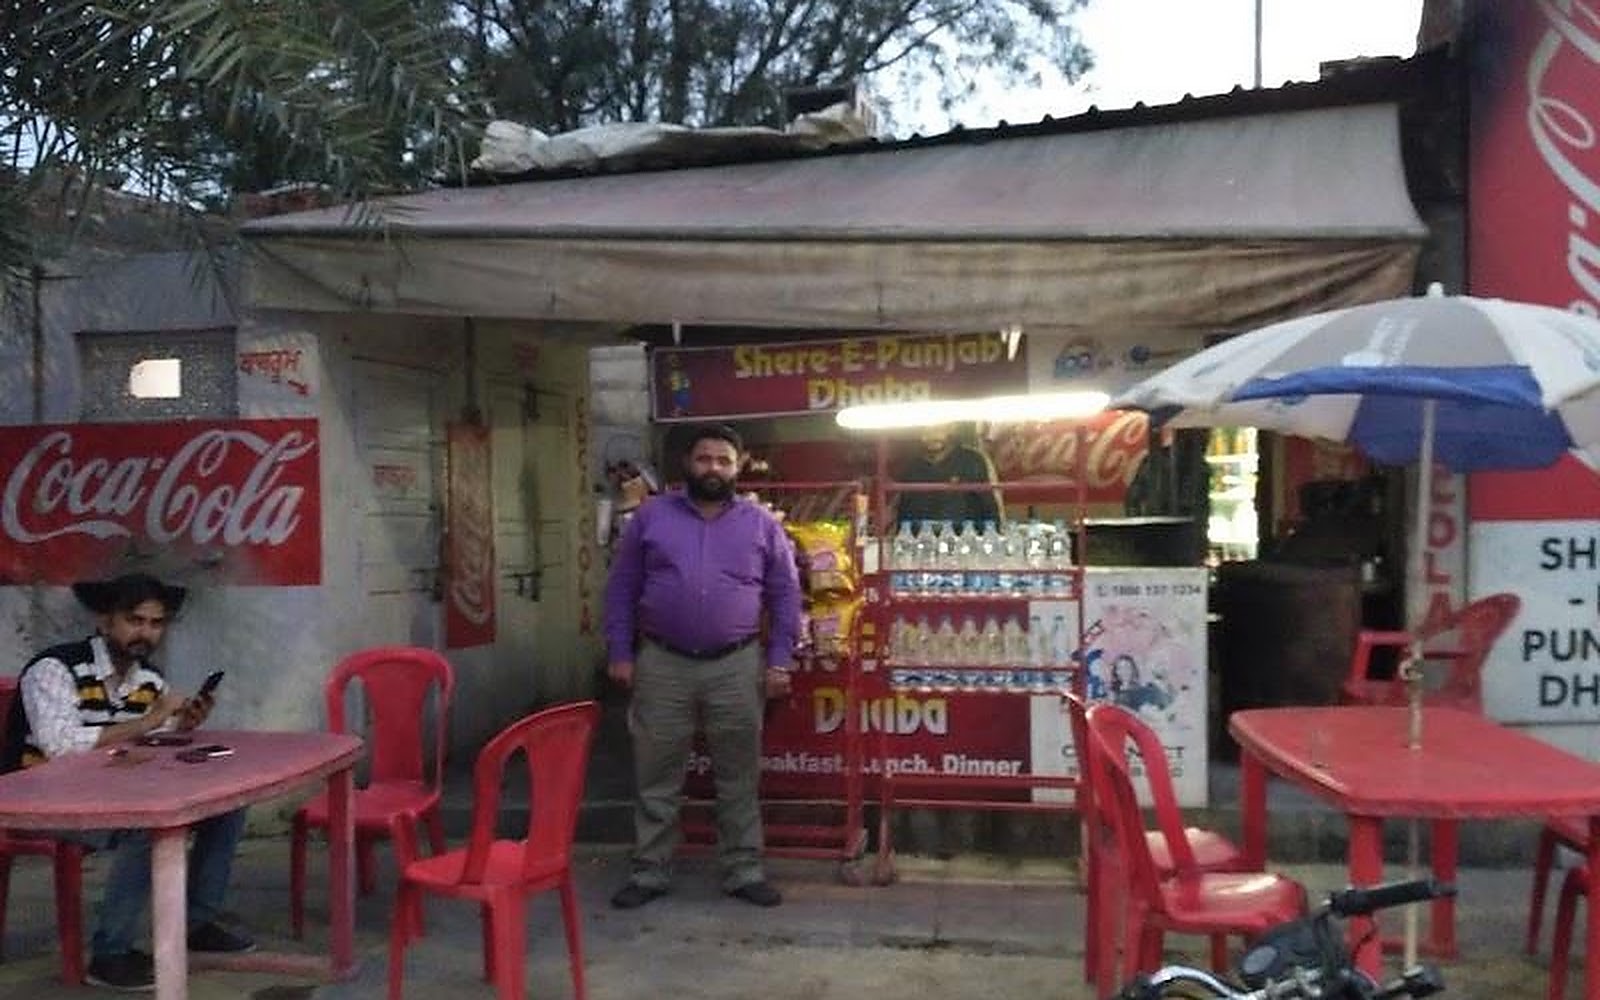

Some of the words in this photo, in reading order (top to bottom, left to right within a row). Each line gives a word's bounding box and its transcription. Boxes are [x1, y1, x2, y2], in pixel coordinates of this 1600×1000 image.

[734, 333, 1001, 379] Shere-E-Punjab
[2, 429, 316, 546] Coca-Cola
[942, 753, 1023, 777] Dinner
